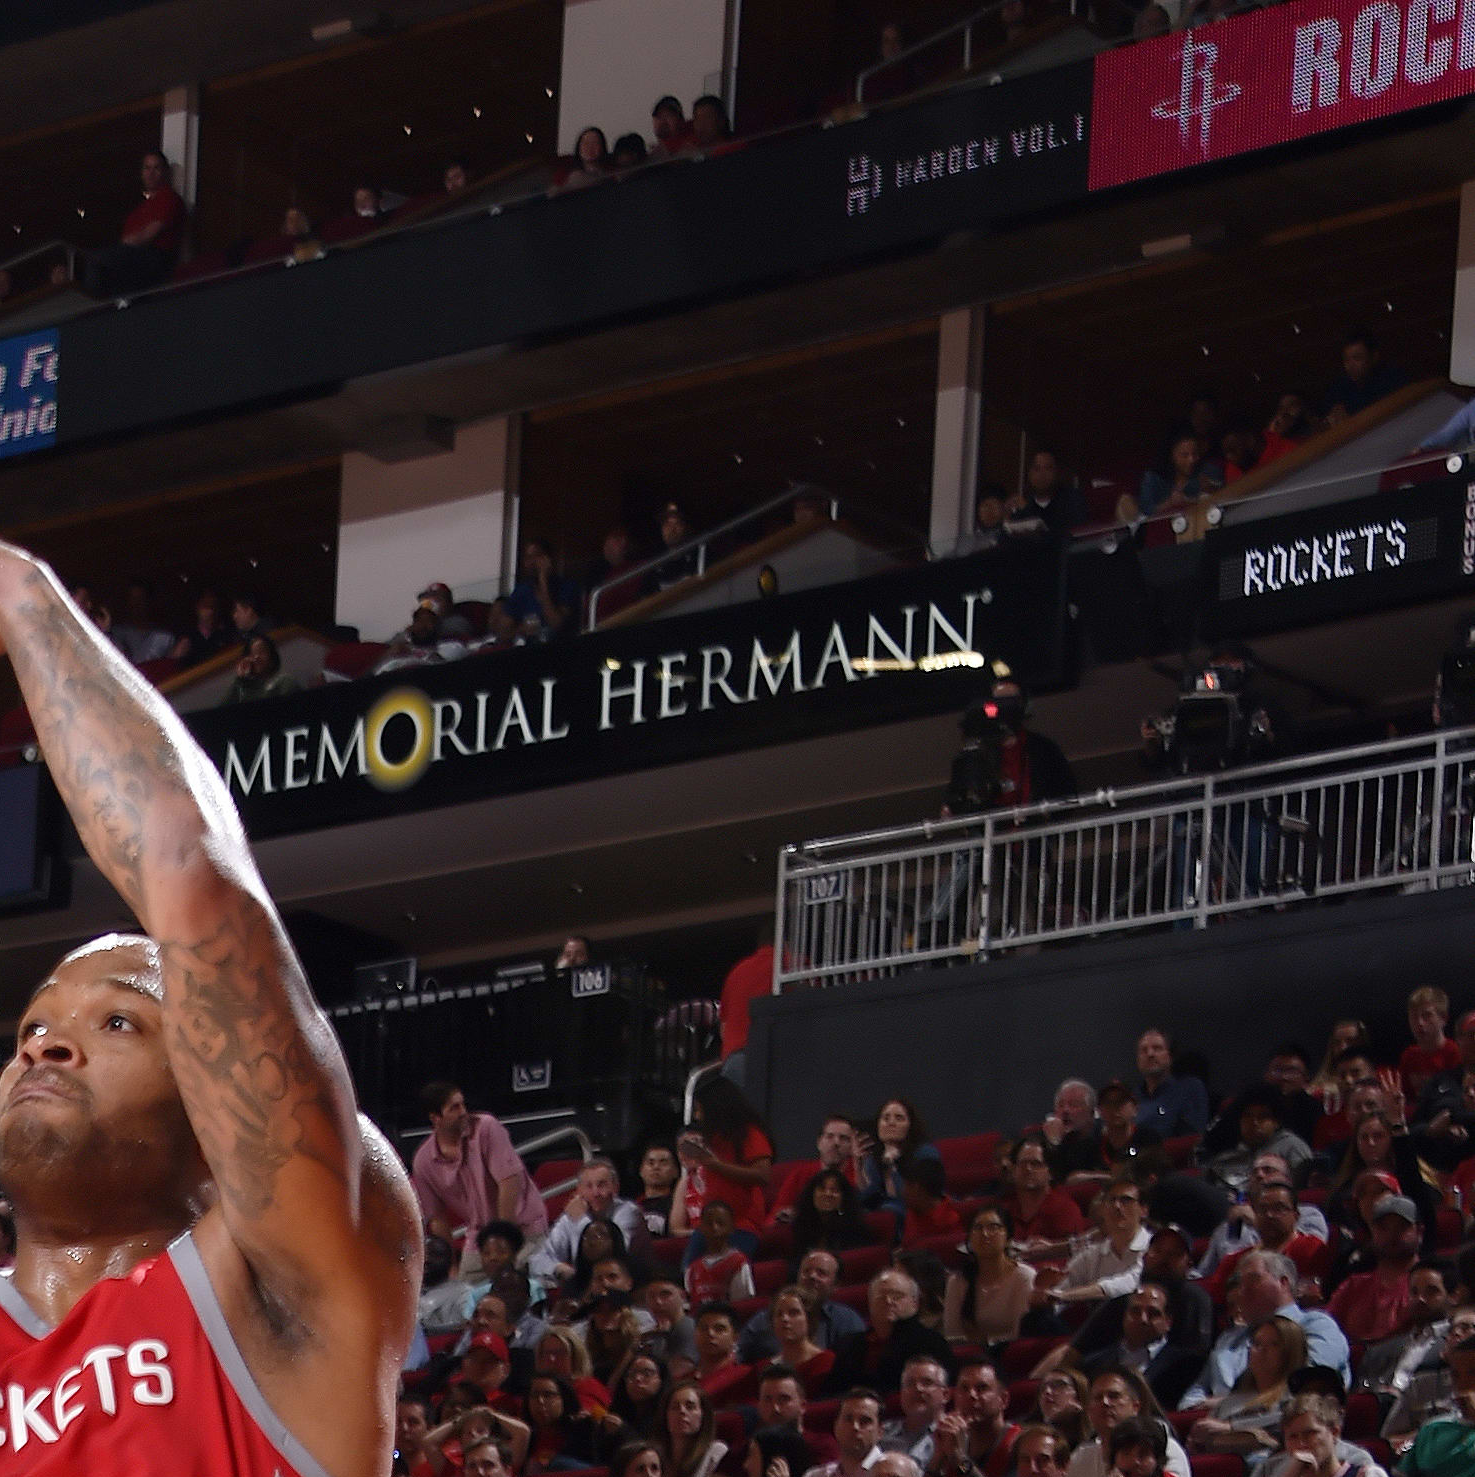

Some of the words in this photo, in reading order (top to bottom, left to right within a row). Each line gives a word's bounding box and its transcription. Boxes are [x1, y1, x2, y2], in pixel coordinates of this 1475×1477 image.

[1292, 0, 1475, 115] ROC
[896, 137, 1000, 190] HARDEN
[1242, 518, 1408, 597] ROCKETS
[223, 679, 569, 797] MEMORIAL
[810, 876, 837, 898] 107
[578, 970, 604, 992] 106
